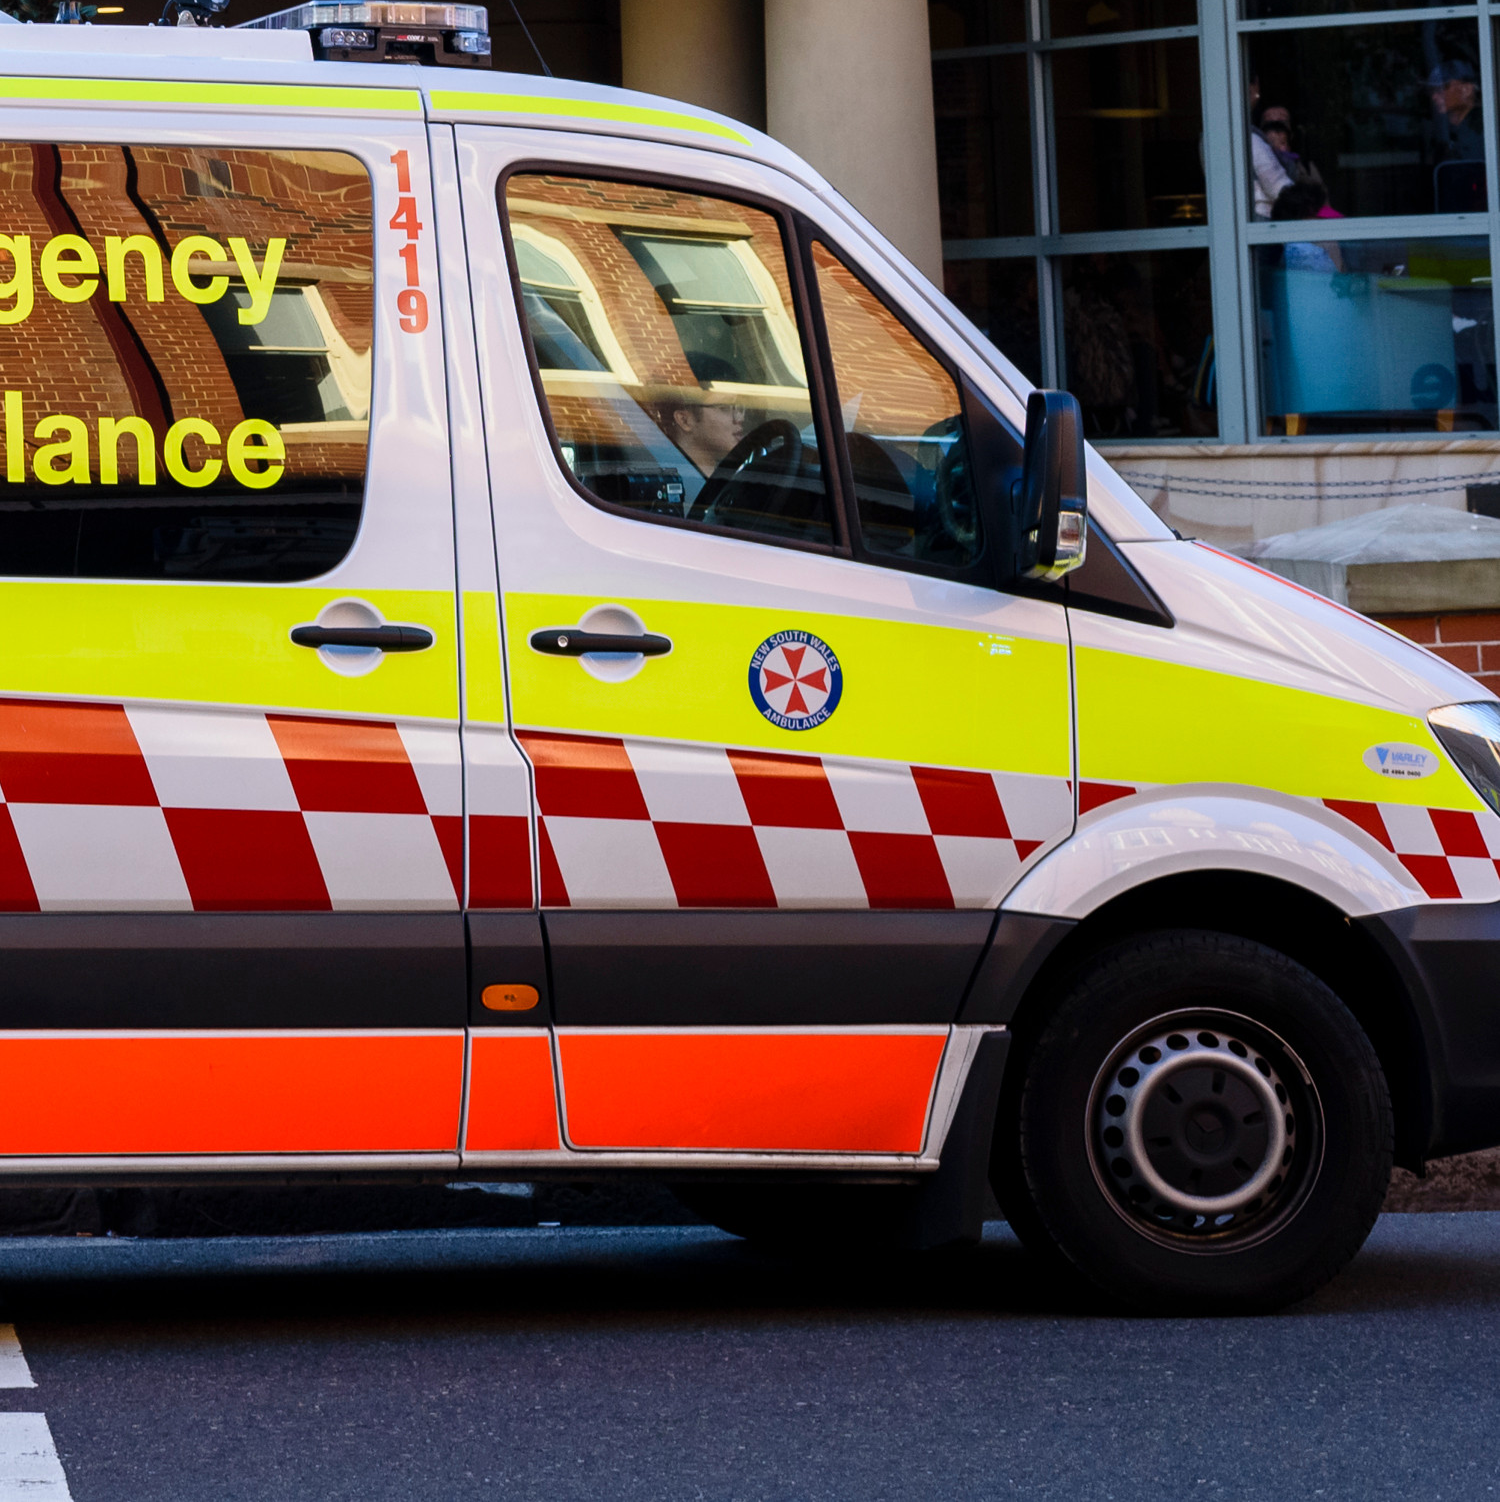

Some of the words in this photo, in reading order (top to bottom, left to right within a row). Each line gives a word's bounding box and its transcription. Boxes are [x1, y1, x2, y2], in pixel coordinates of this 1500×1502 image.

[389, 150, 429, 334] 1419
[751, 642, 771, 670] NEW
[769, 630, 808, 647] SOUTH
[810, 635, 840, 672] WALES
[763, 706, 831, 730] AMBULANCE
[1391, 752, 1427, 764] VARLEY
